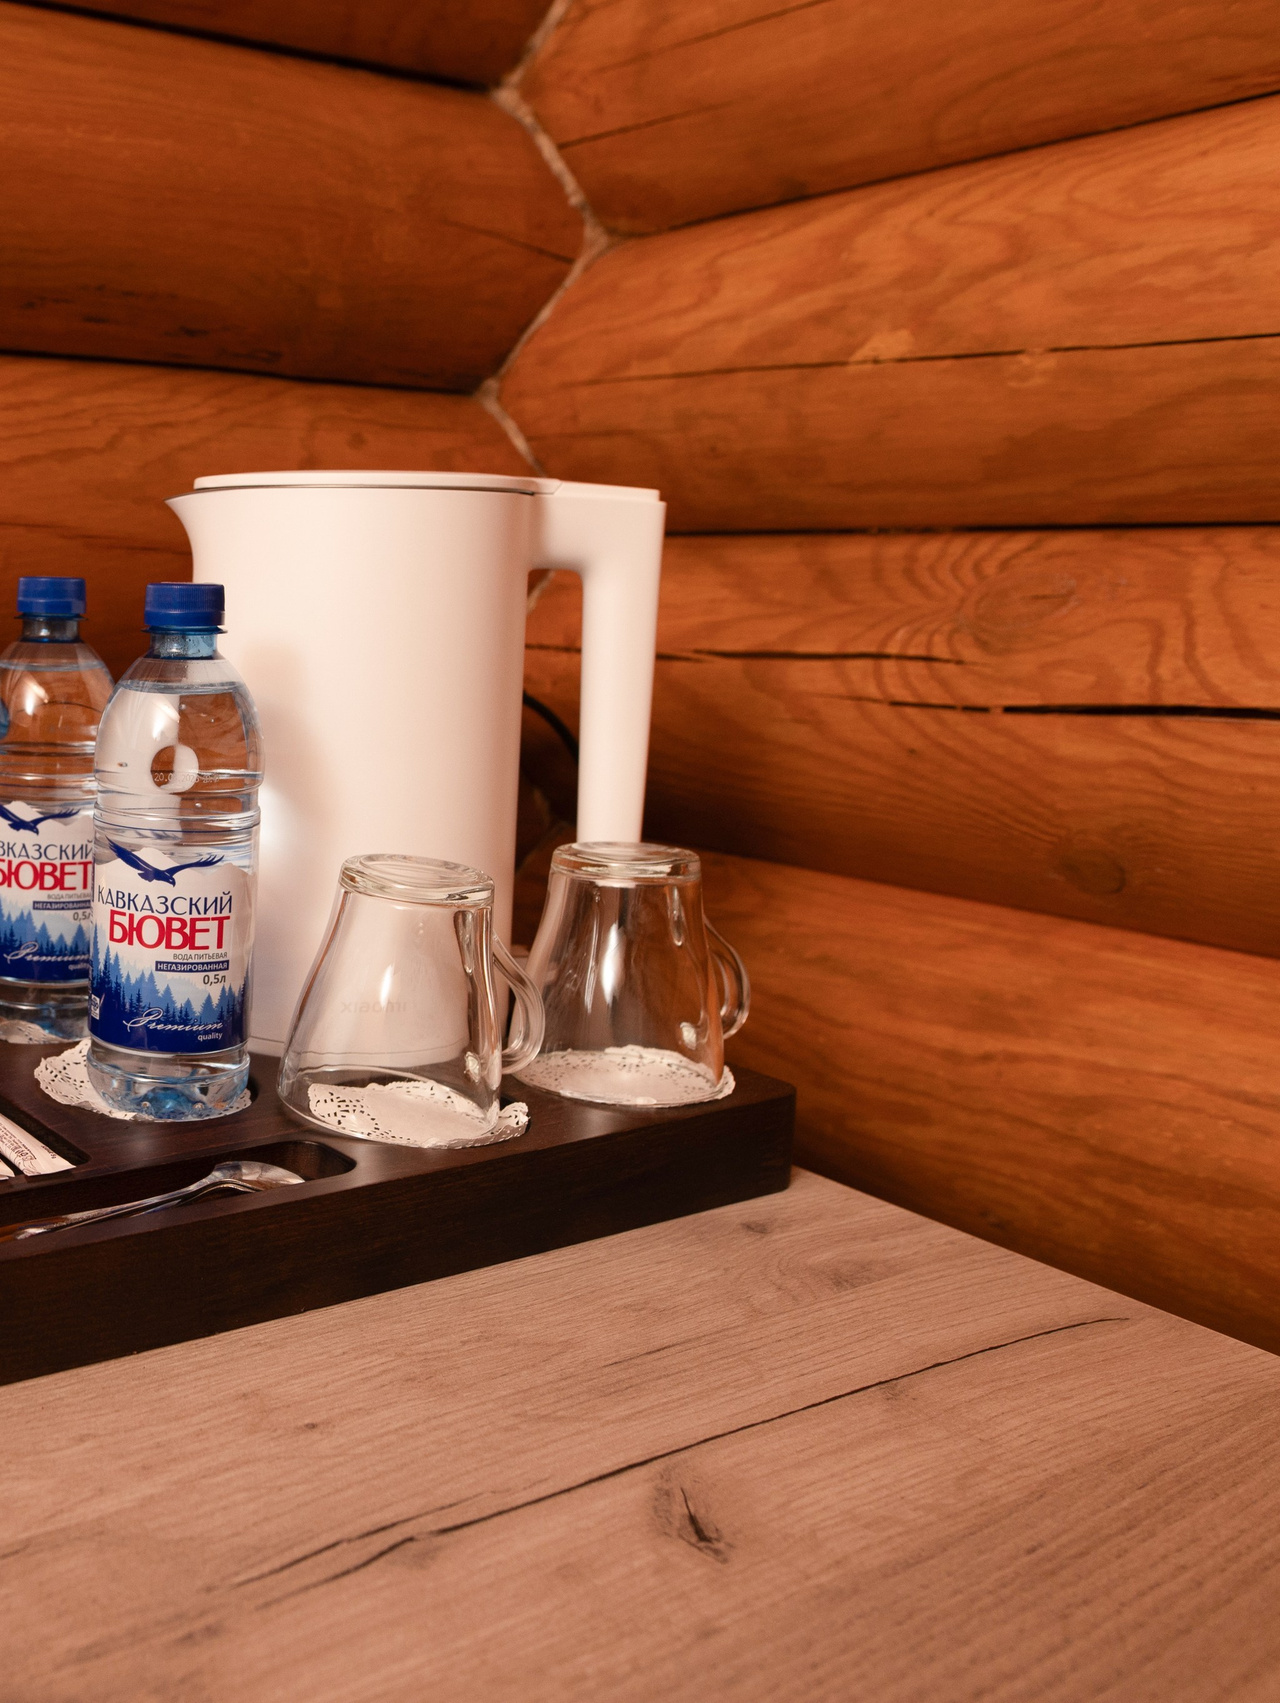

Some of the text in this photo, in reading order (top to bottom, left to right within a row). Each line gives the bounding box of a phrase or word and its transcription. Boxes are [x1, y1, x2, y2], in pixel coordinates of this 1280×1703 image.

[98, 885, 232, 914] КАВКАЗСКИЙ
[109, 909, 231, 951] БЮВЕТ
[172, 952, 228, 961] ВОДА ПИТЬЕВАЯ
[157, 961, 228, 972] НЕГАЗИРОВАННАЯ
[202, 973, 226, 986] 0,5л
[123, 1007, 224, 1032] Premium
[197, 1032, 224, 1042] quality
